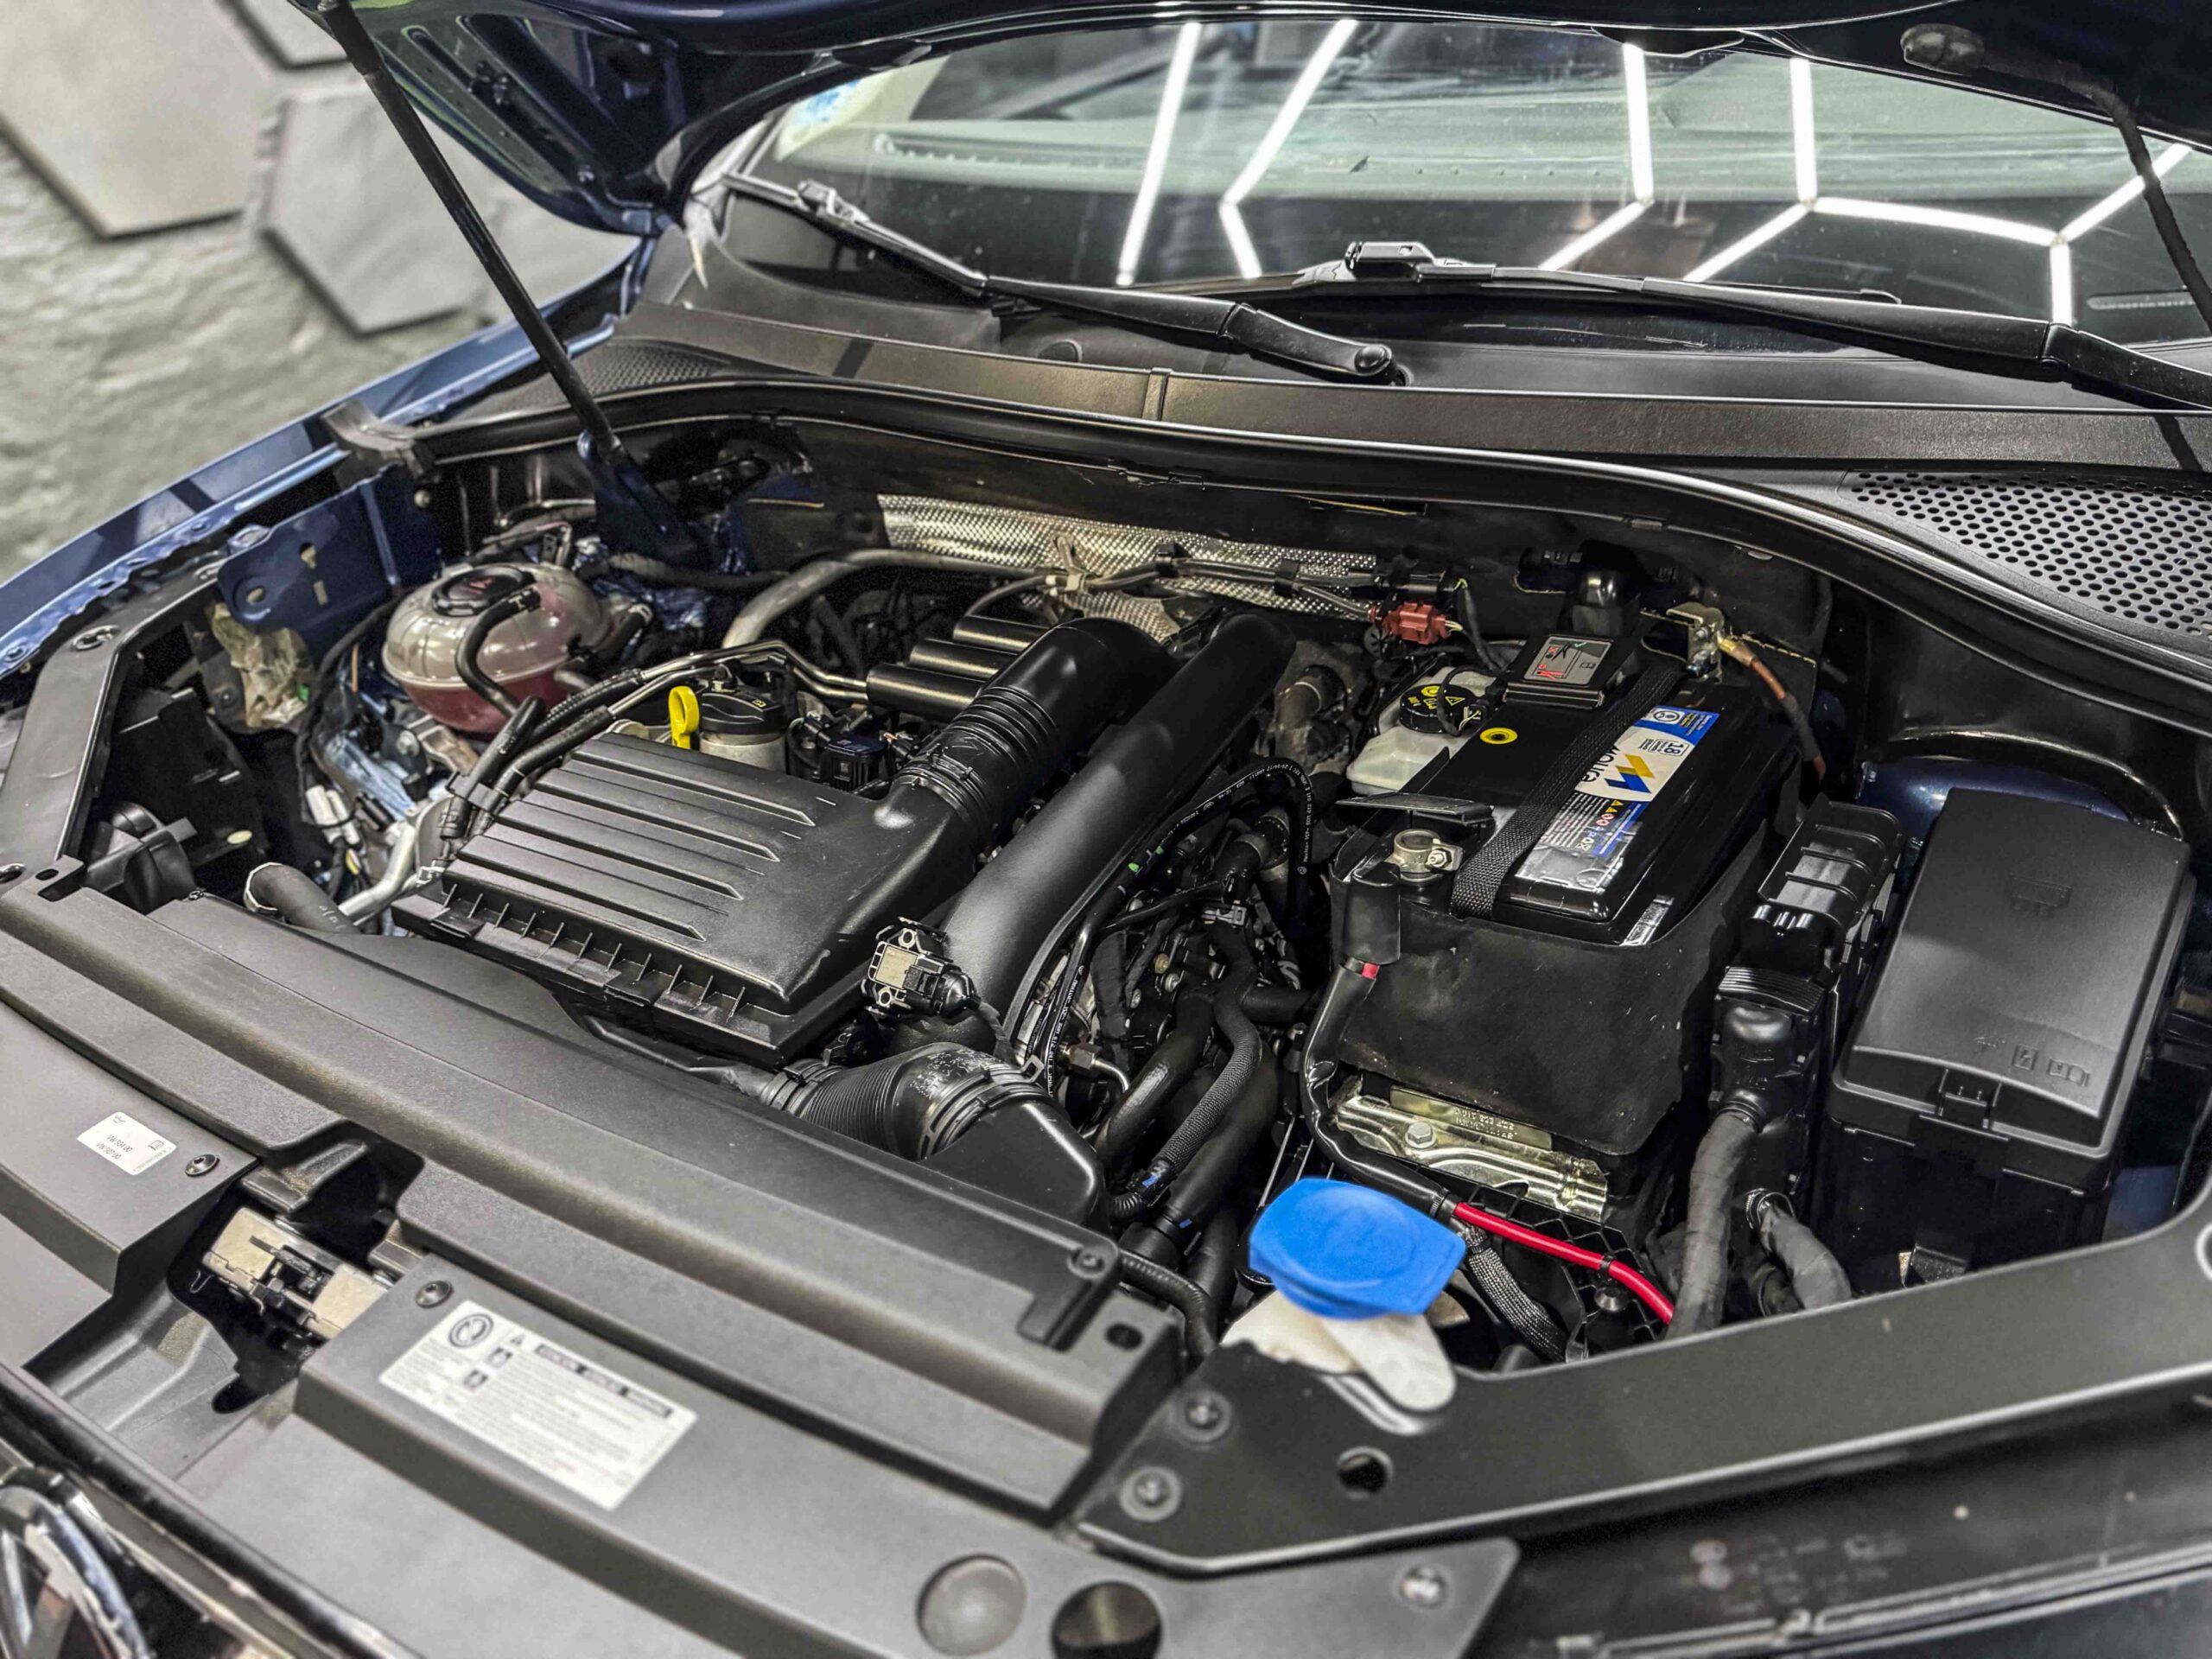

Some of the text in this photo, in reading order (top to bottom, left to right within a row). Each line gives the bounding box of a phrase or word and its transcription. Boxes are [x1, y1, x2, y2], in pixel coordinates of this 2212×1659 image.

[1663, 743, 1684, 754] 18
[106, 1135, 117, 1143] VW
[96, 1141, 105, 1150] VW
